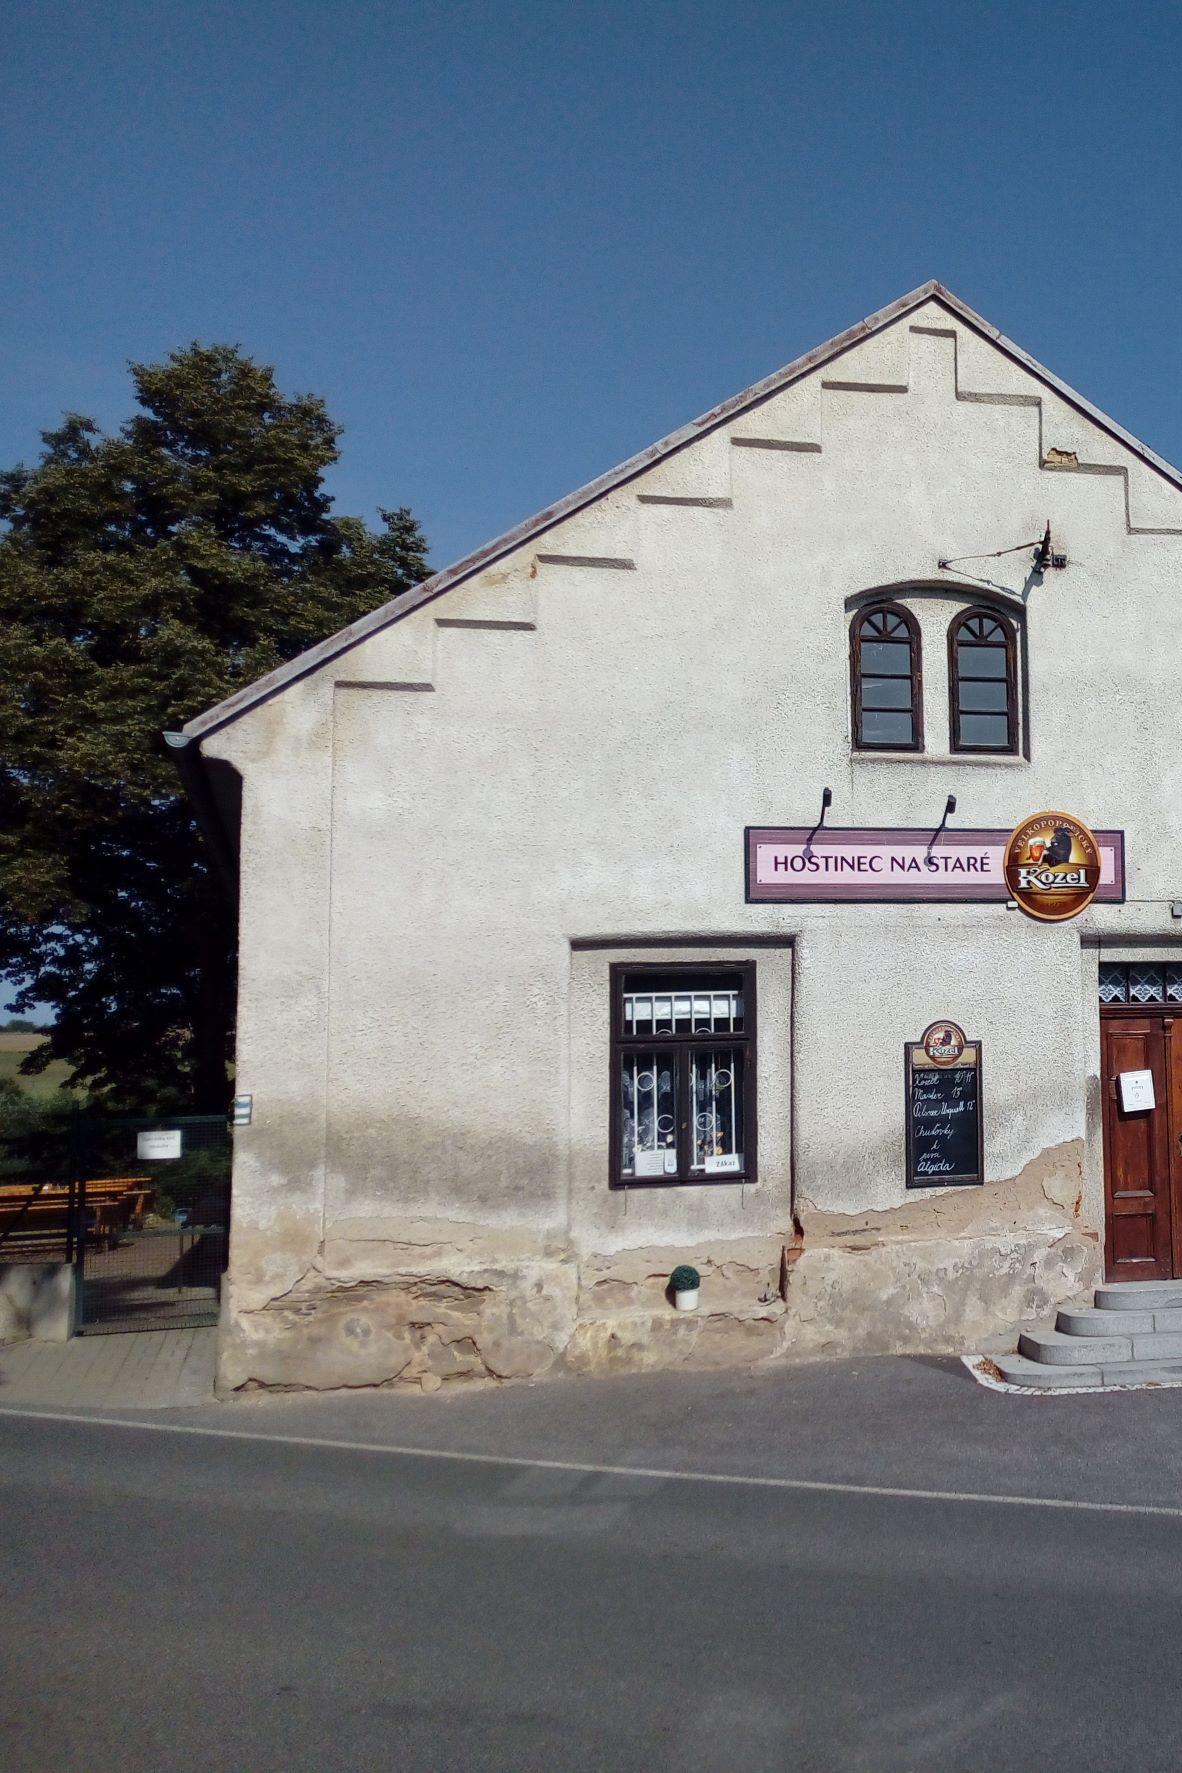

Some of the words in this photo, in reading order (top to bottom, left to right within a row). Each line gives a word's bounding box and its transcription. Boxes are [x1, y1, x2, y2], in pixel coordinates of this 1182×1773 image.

[773, 855, 883, 873] HOSTINEC
[890, 856, 922, 873] NA
[927, 851, 992, 873] STARÉ
[1017, 866, 1090, 890] Kozel
